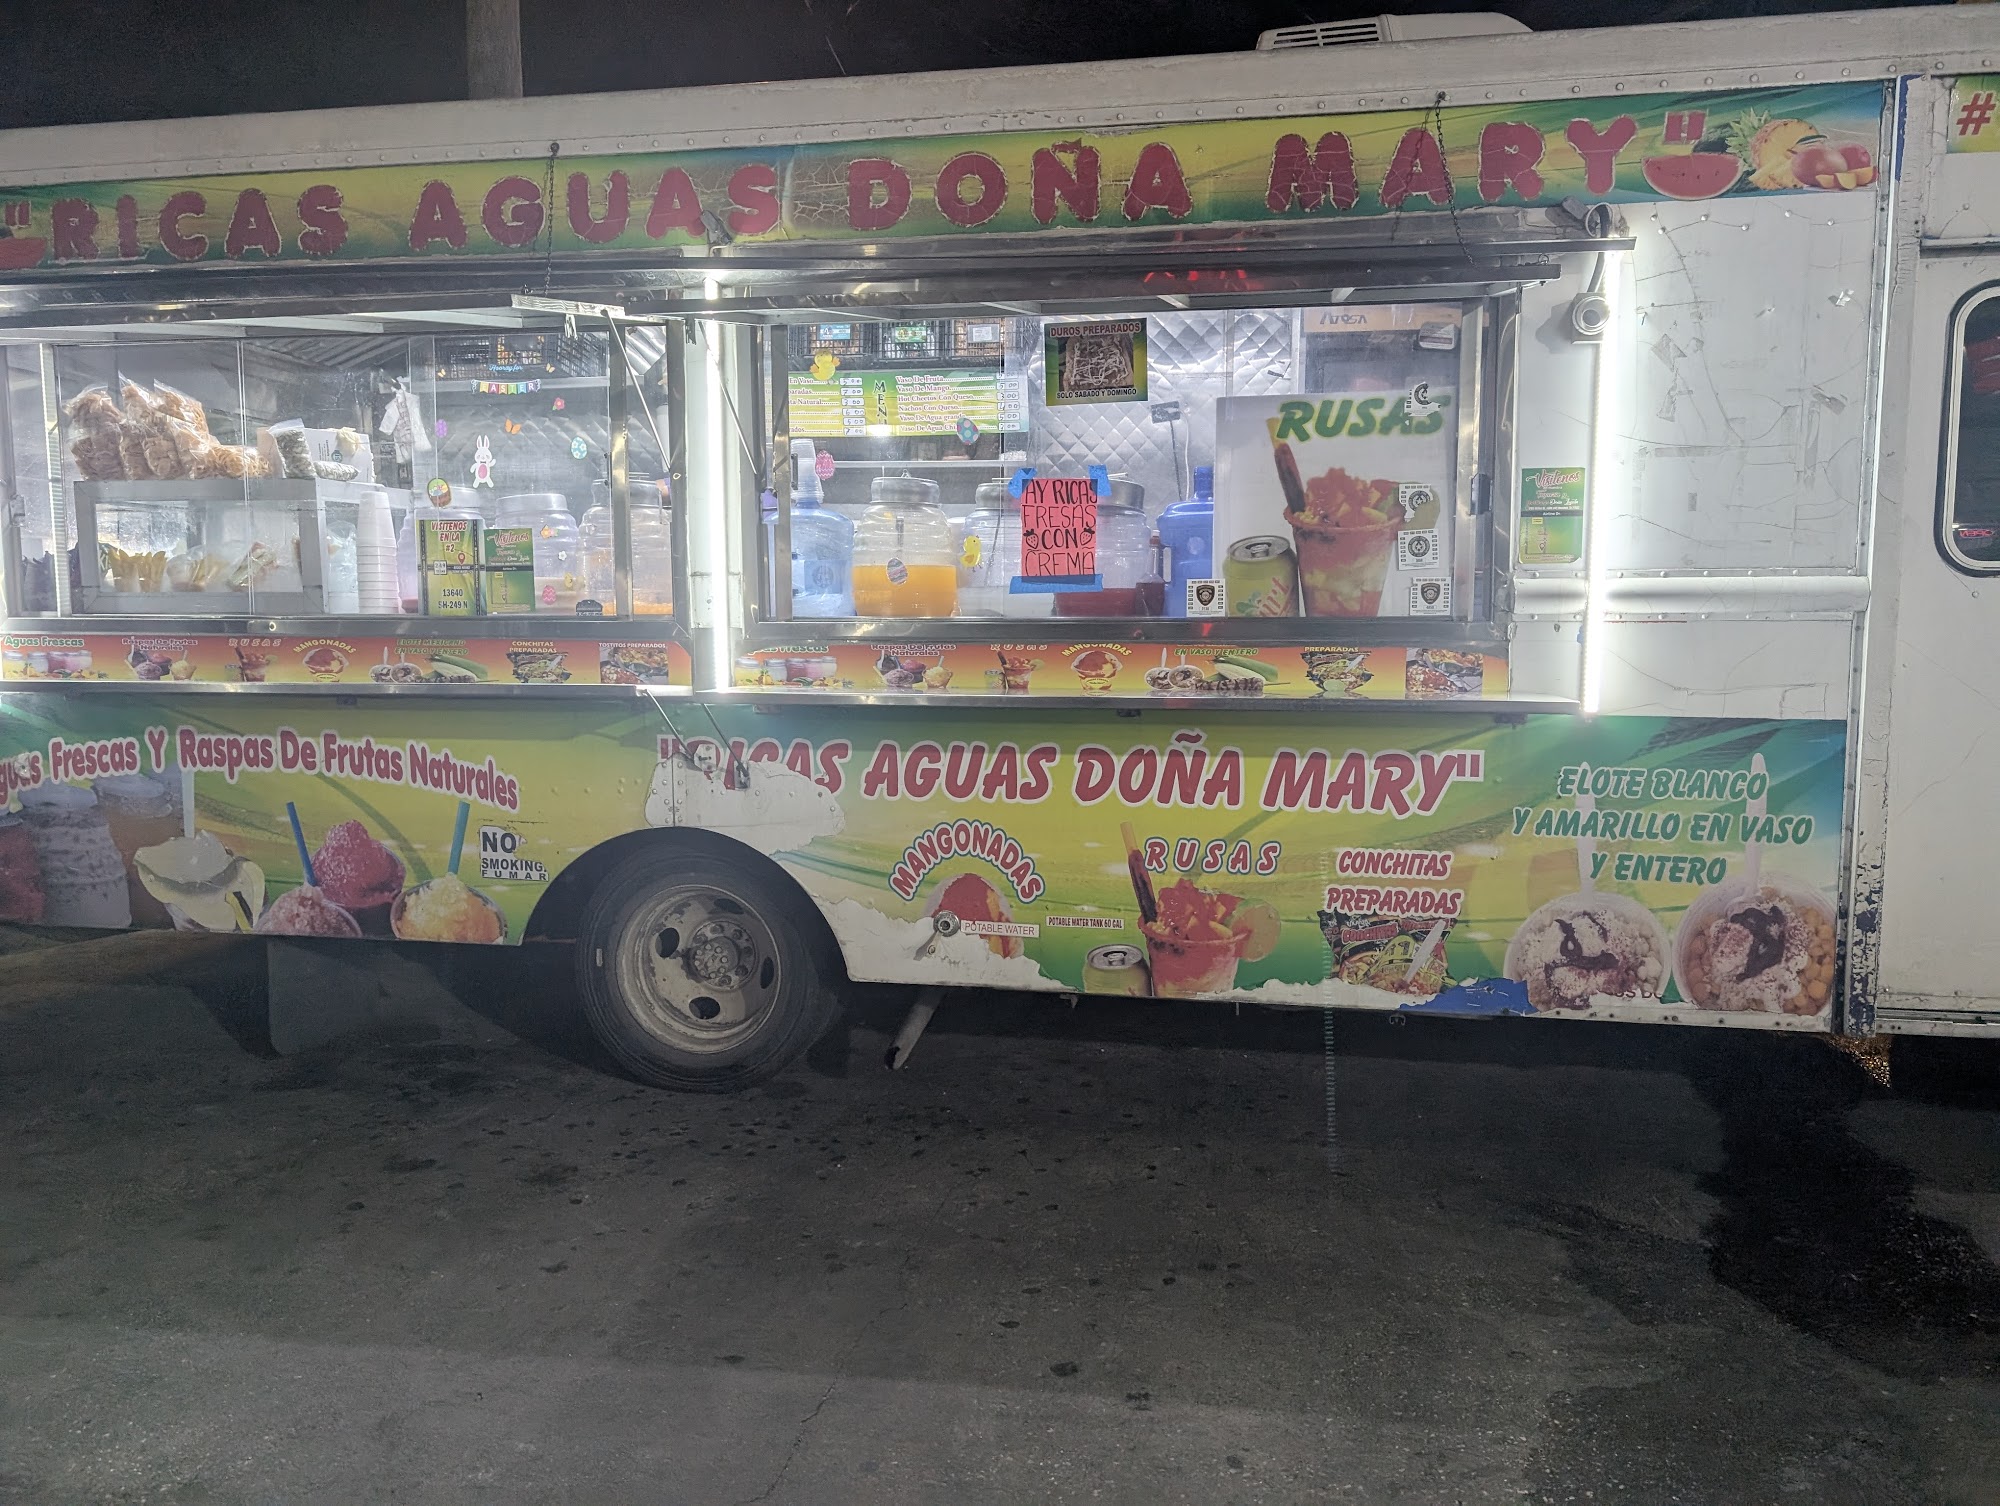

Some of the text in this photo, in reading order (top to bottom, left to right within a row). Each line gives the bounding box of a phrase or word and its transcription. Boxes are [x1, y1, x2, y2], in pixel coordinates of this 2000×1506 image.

[408, 162, 781, 252] AGUAS
[846, 138, 1195, 232] DOÑA
[1264, 108, 1707, 213] MARY"
[1050, 322, 1141, 337] DUROS PREPARADOS
[798, 375, 814, 384] Vaso
[896, 375, 913, 384] Vaso
[913, 375, 924, 384] De
[925, 374, 944, 383] Fruta
[482, 381, 535, 392] EASTER
[897, 384, 914, 392] Vaso
[914, 383, 925, 392] De
[926, 383, 950, 394] Mango
[898, 393, 911, 402] Hot
[911, 392, 938, 402] Cheetos
[938, 391, 952, 401] Con
[952, 391, 974, 402] Queso
[1056, 391, 1073, 399] SOLO
[1074, 390, 1100, 398] SABADO
[1106, 388, 1137, 396] DOMINGO
[797, 397, 822, 405] Natural
[898, 404, 923, 412] Nachos
[923, 403, 937, 411] Con
[937, 403, 959, 413] Queso
[900, 413, 915, 422] Vaso
[915, 413, 926, 421] De
[926, 413, 943, 423] Agua
[1276, 394, 1452, 442] RUSAS
[916, 423, 927, 431] De
[927, 423, 944, 433] Agua
[1526, 469, 1582, 489] Visitenos
[1052, 479, 1098, 504] RICAS
[1021, 504, 1097, 528] FRESAS
[431, 521, 468, 531] VISITENOS
[440, 532, 460, 542] EN LA
[1041, 527, 1079, 550] CON
[445, 544, 455, 553] #2
[1024, 550, 1095, 577] CREMA
[442, 588, 464, 597] 13640
[437, 600, 468, 609] SH-249 N
[5, 636, 85, 648] Aguas Frescas
[122, 638, 155, 646] Raspas
[170, 638, 198, 646] Frutas
[228, 638, 282, 647] RUSAS
[293, 638, 357, 655] MANGONADAS
[511, 640, 554, 648] CONCHITAS
[871, 644, 907, 652] Raspas
[1174, 648, 1259, 656] EN VASO Y ENTERO
[1304, 645, 1360, 653] PREPARADAS
[51, 740, 138, 782] Frescas
[147, 729, 166, 769] Y
[179, 728, 273, 781] Raspas
[281, 730, 316, 770] De
[323, 733, 402, 781] Frutas
[408, 744, 519, 812] Naturales
[864, 743, 1057, 799] AGUAS
[1074, 733, 1243, 807] DOÑA
[1263, 750, 1481, 816] MARY"
[1558, 766, 1768, 800] ELOTE BLANCO
[1513, 808, 1815, 845] Y AMARILLO EN VASO
[482, 831, 517, 853] NO
[891, 822, 1043, 901] MANGONADAS
[1146, 839, 1280, 874] RUSAS
[1338, 849, 1451, 877] CONCHITAS
[1590, 852, 1728, 885] Y ENTERO
[482, 870, 547, 880] FUMAR
[1326, 887, 1462, 915] PREPARADAS
[964, 921, 1035, 936] POTABLE WATER
[1048, 917, 1123, 929] POTABLE WATER TANK 60 GAL
